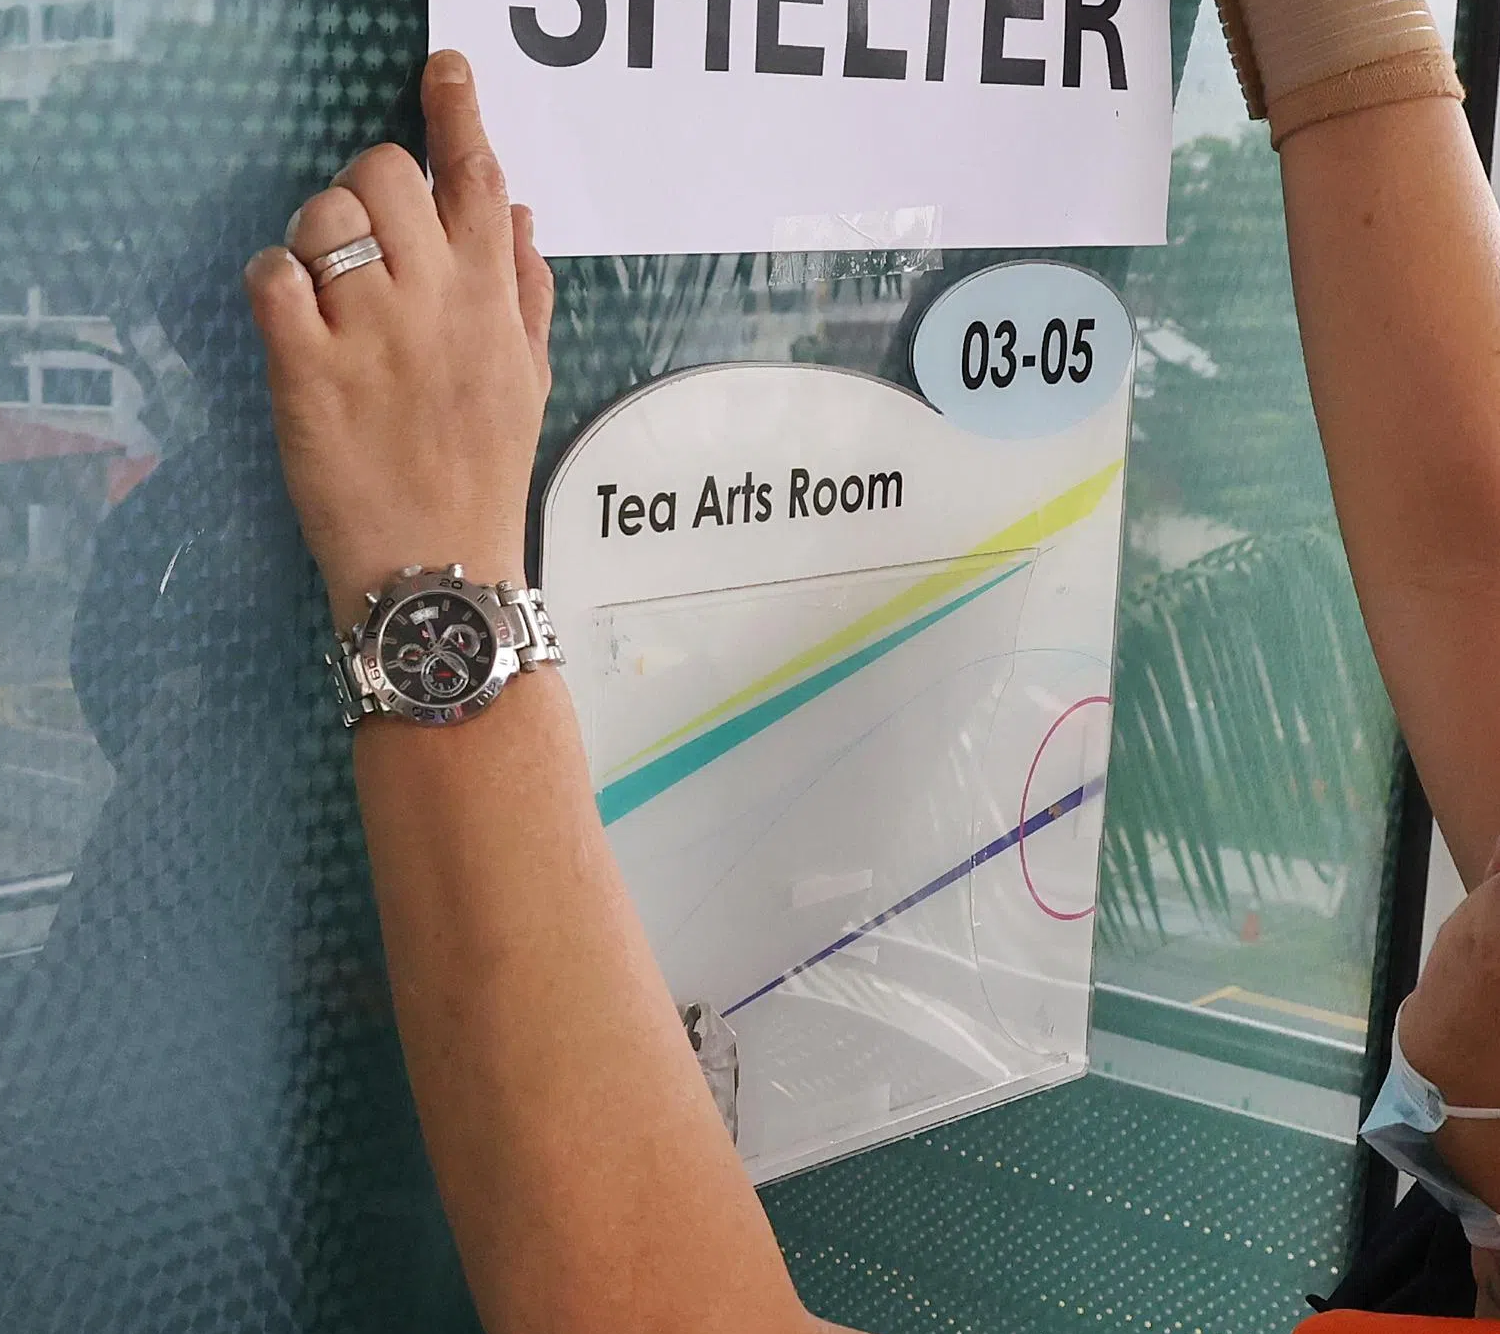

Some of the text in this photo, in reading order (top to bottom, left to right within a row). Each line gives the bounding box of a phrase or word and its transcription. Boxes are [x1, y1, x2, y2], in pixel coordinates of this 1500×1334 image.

[961, 317, 1096, 391] 03-05
[597, 468, 903, 538] Tea Arts Room
[439, 578, 463, 590] 20
